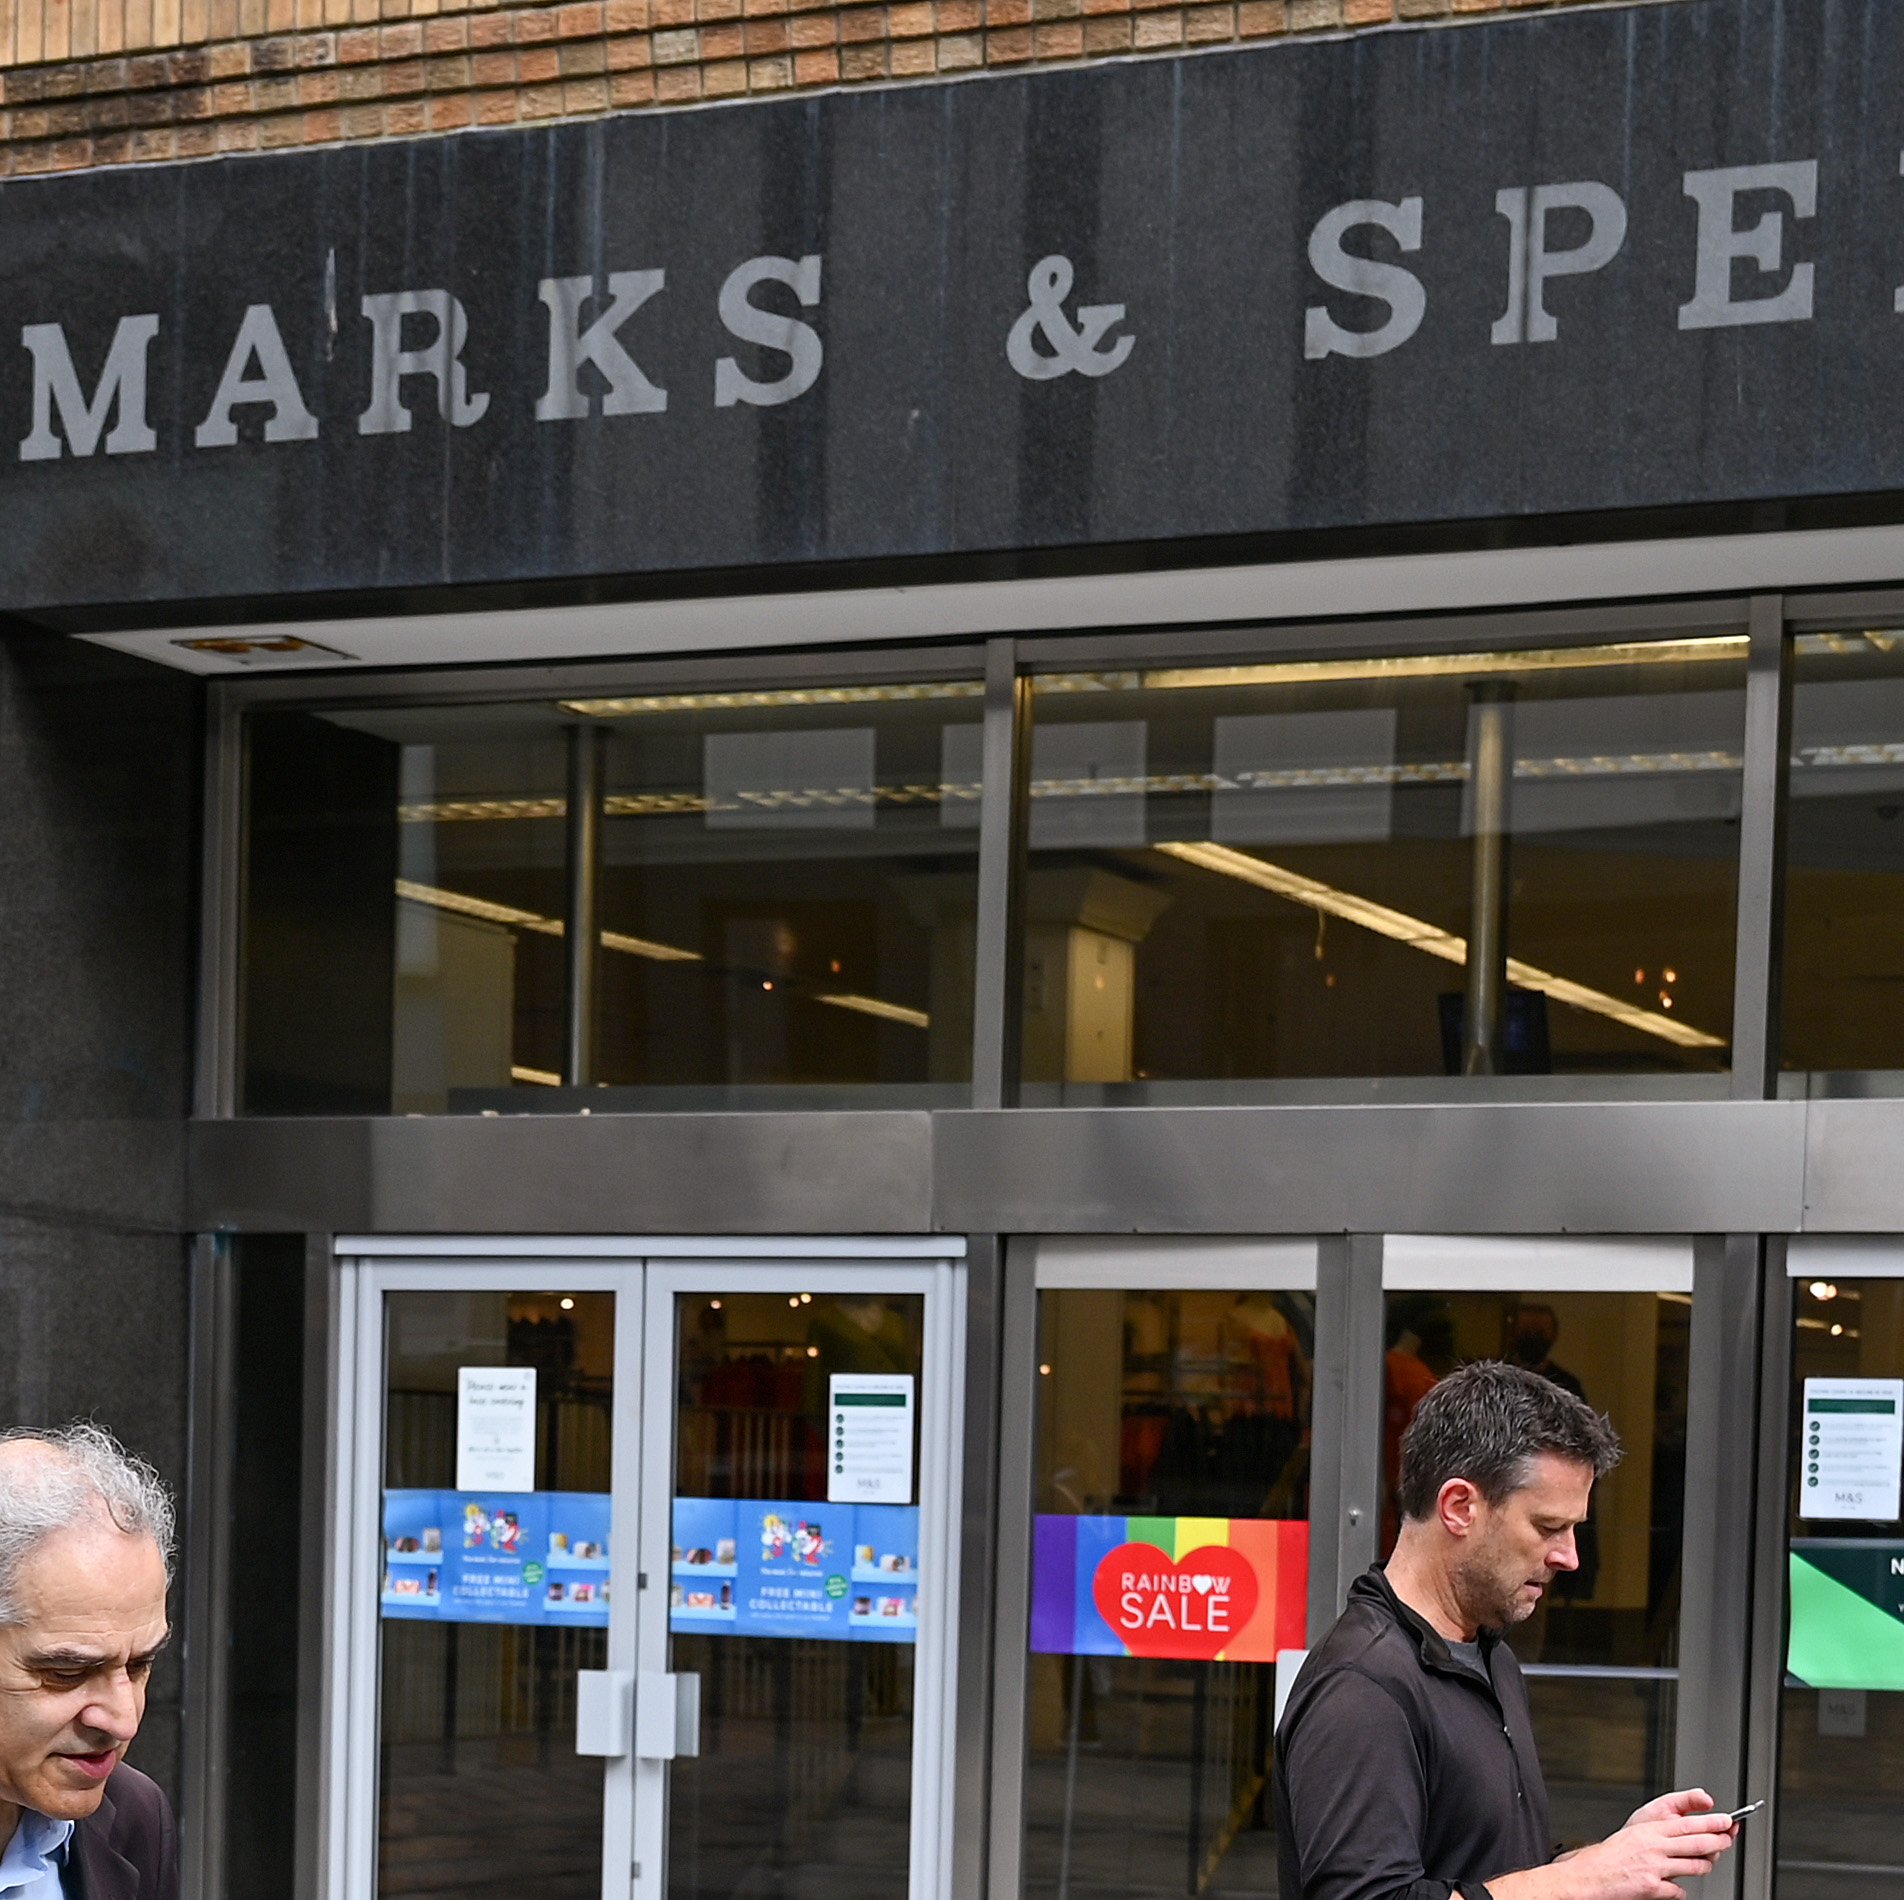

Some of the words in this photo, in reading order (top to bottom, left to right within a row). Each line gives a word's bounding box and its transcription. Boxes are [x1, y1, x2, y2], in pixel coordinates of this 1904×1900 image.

[19, 255, 825, 461] MARKS
[1006, 254, 1137, 382] &
[1120, 1591, 1231, 1632] SALE
